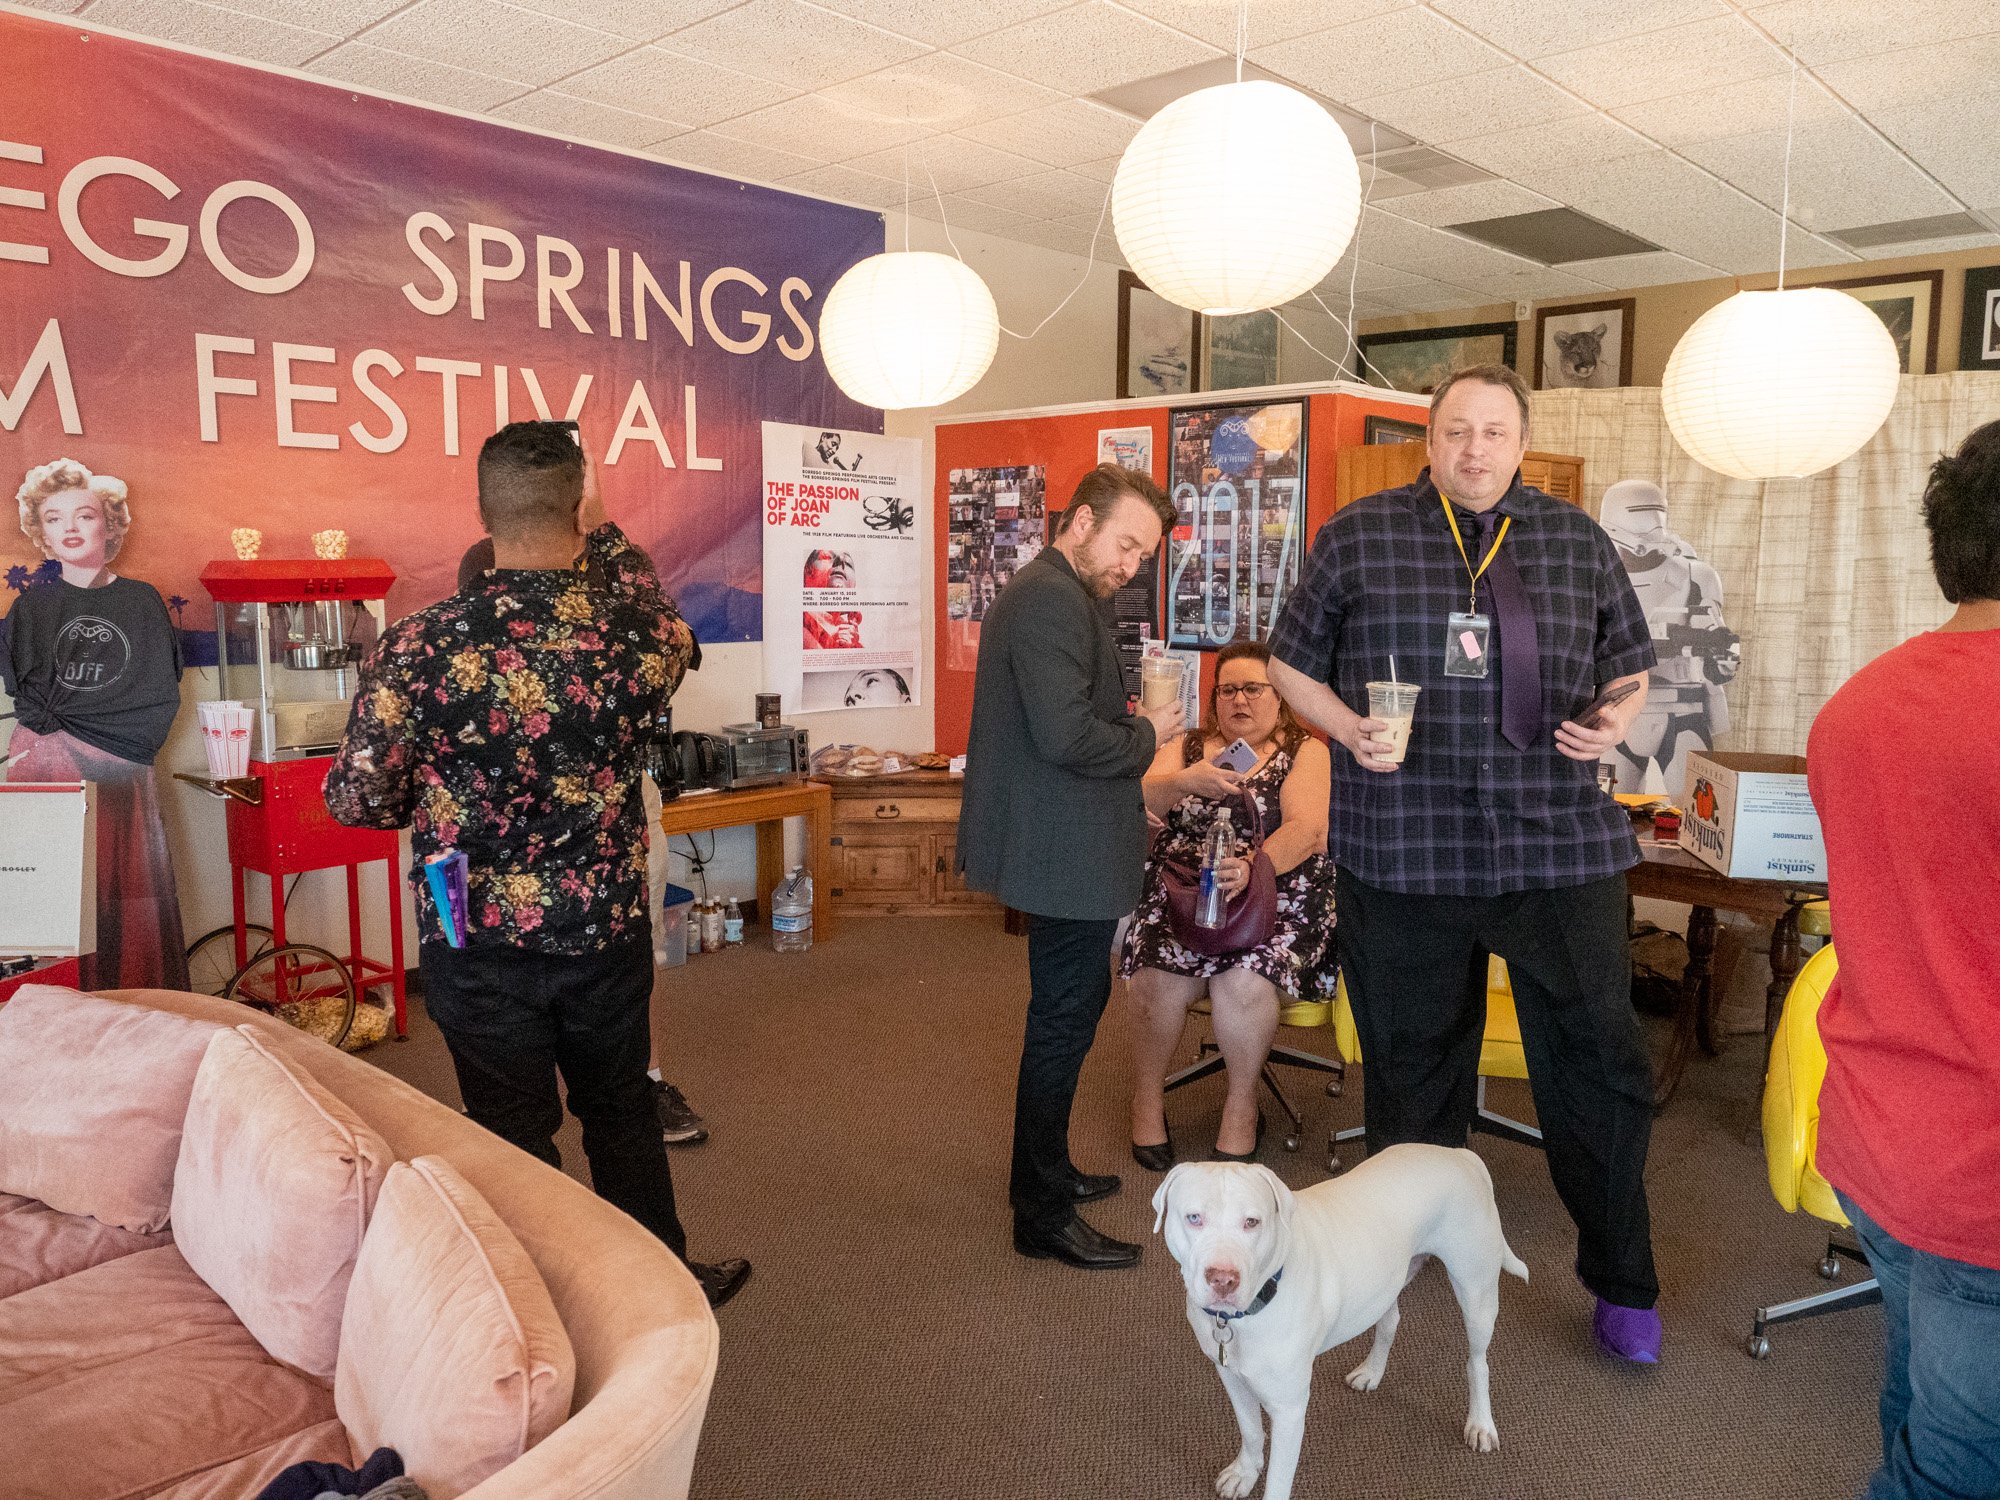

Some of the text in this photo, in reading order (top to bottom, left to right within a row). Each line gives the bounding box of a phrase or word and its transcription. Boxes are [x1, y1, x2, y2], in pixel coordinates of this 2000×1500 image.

[401, 211, 815, 362] SPRINGS
[194, 332, 723, 472] FESTIVAL
[767, 481, 860, 501] THE PASSION
[767, 496, 830, 513] OF JOAN
[767, 512, 821, 528] OF ARC
[1167, 477, 1301, 645] 2017
[64, 661, 105, 682] BSFF
[1683, 807, 1726, 860] Sunkist
[1772, 832, 1814, 840] STRATHMORE
[1767, 861, 1816, 875] Sunkist
